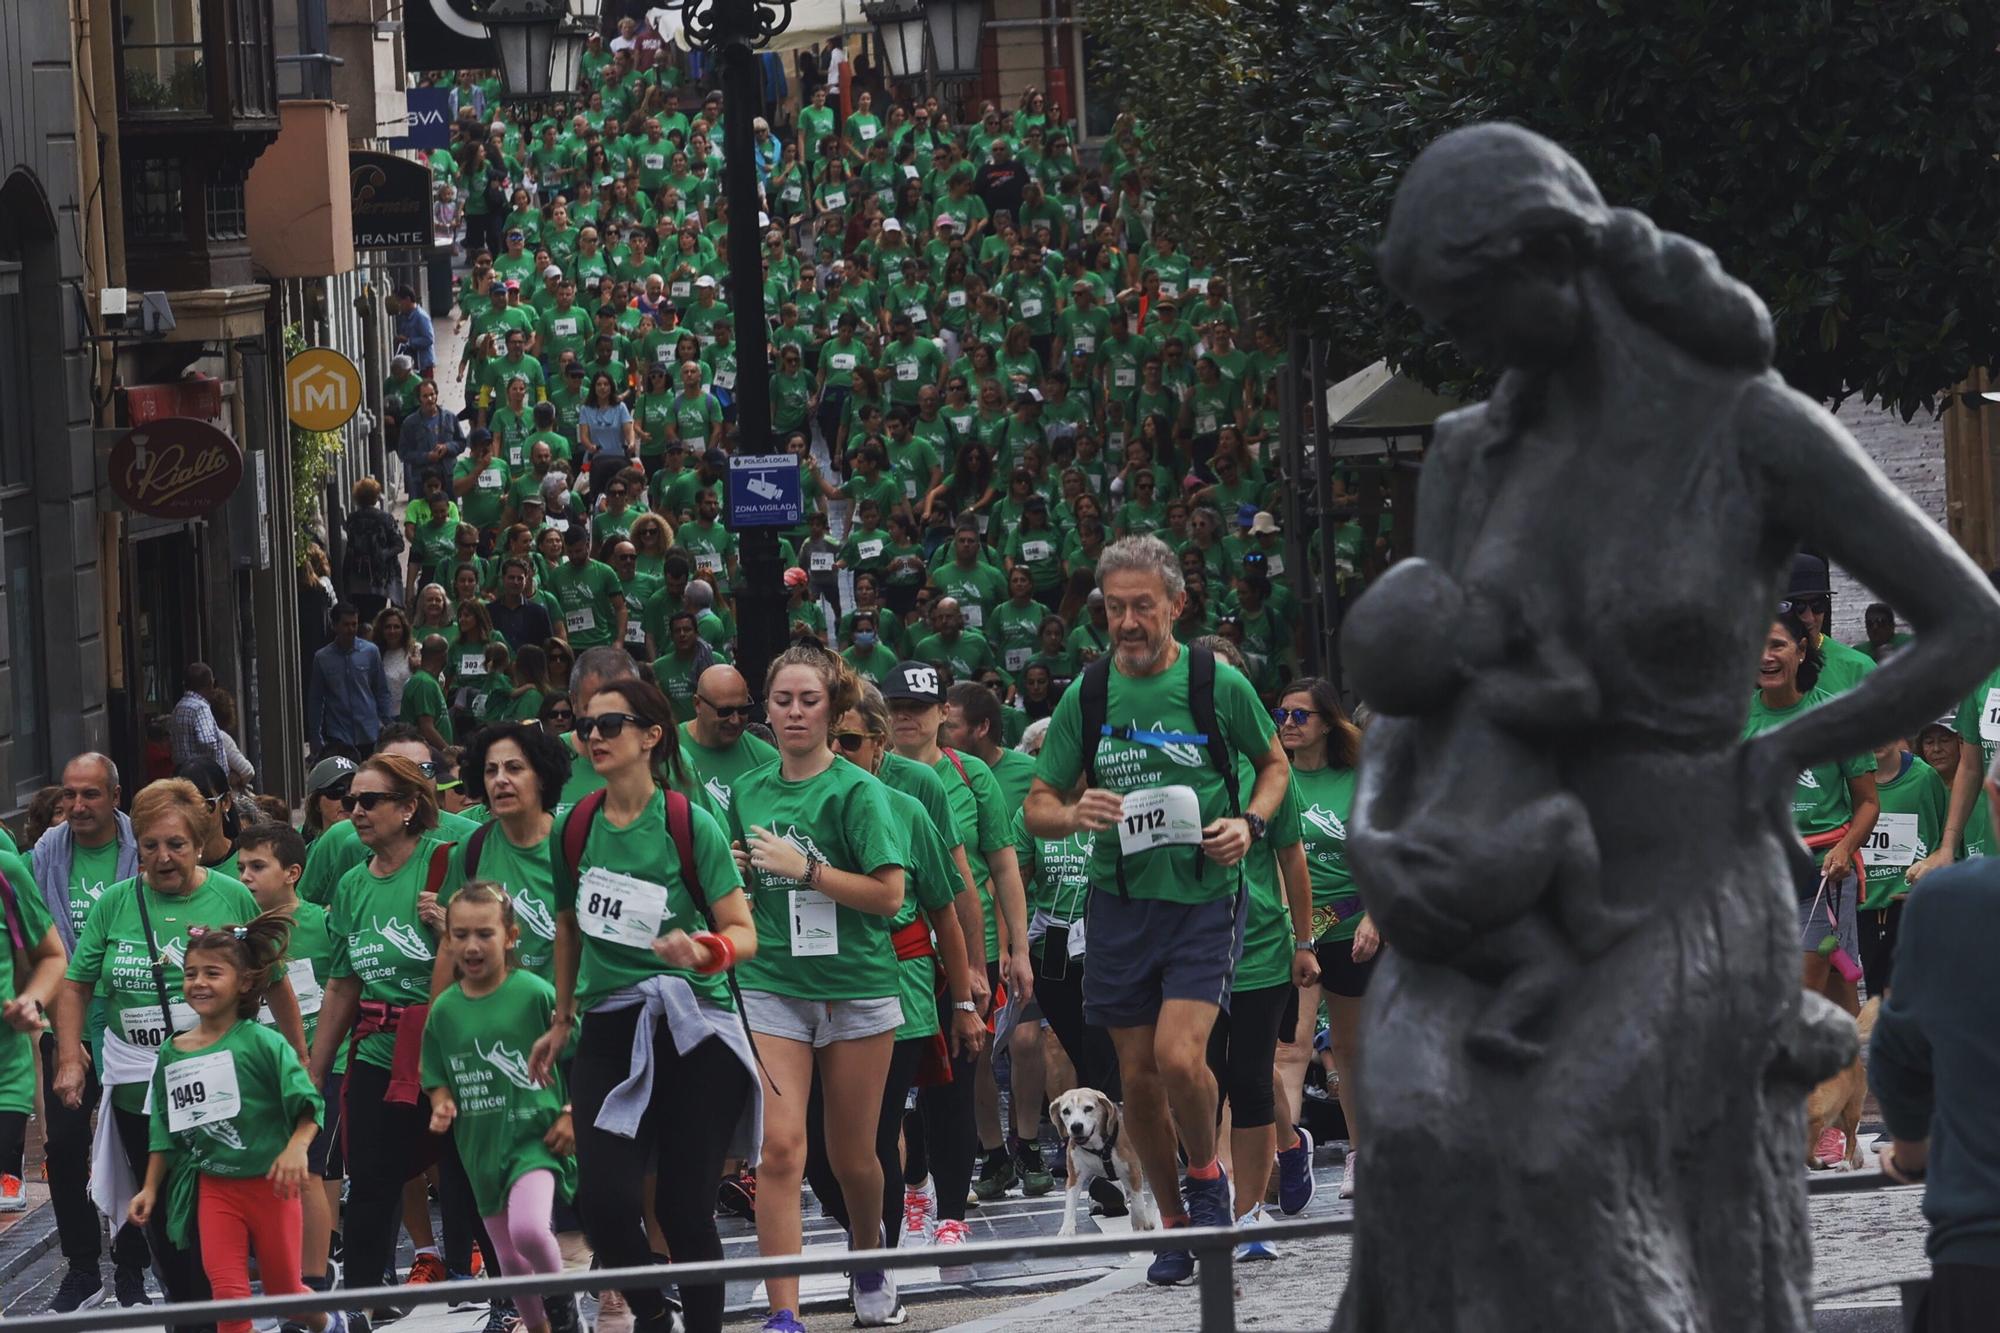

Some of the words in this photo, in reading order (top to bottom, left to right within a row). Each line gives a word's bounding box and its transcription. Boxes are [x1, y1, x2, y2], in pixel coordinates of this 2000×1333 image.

[127, 444, 229, 500] Rialto
[735, 505, 758, 513] ZONA
[760, 503, 797, 512] VIGILADA
[1097, 740, 1112, 753] En
[1097, 747, 1148, 766] marcha
[1101, 762, 1141, 777] contra
[1117, 770, 1163, 788] cáncer
[1124, 808, 1167, 836] 1712
[1044, 844, 1059, 853] En
[1044, 854, 1085, 864] marcha
[1045, 864, 1079, 873] contra
[1869, 865, 1903, 878] cáncer
[588, 892, 623, 921] 814
[118, 942, 133, 954] En
[114, 954, 154, 967] march
[112, 966, 153, 979] contra
[112, 977, 122, 988] el
[125, 979, 171, 991] cáncr
[455, 1068, 494, 1085] marcha
[170, 1081, 206, 1110] 1949
